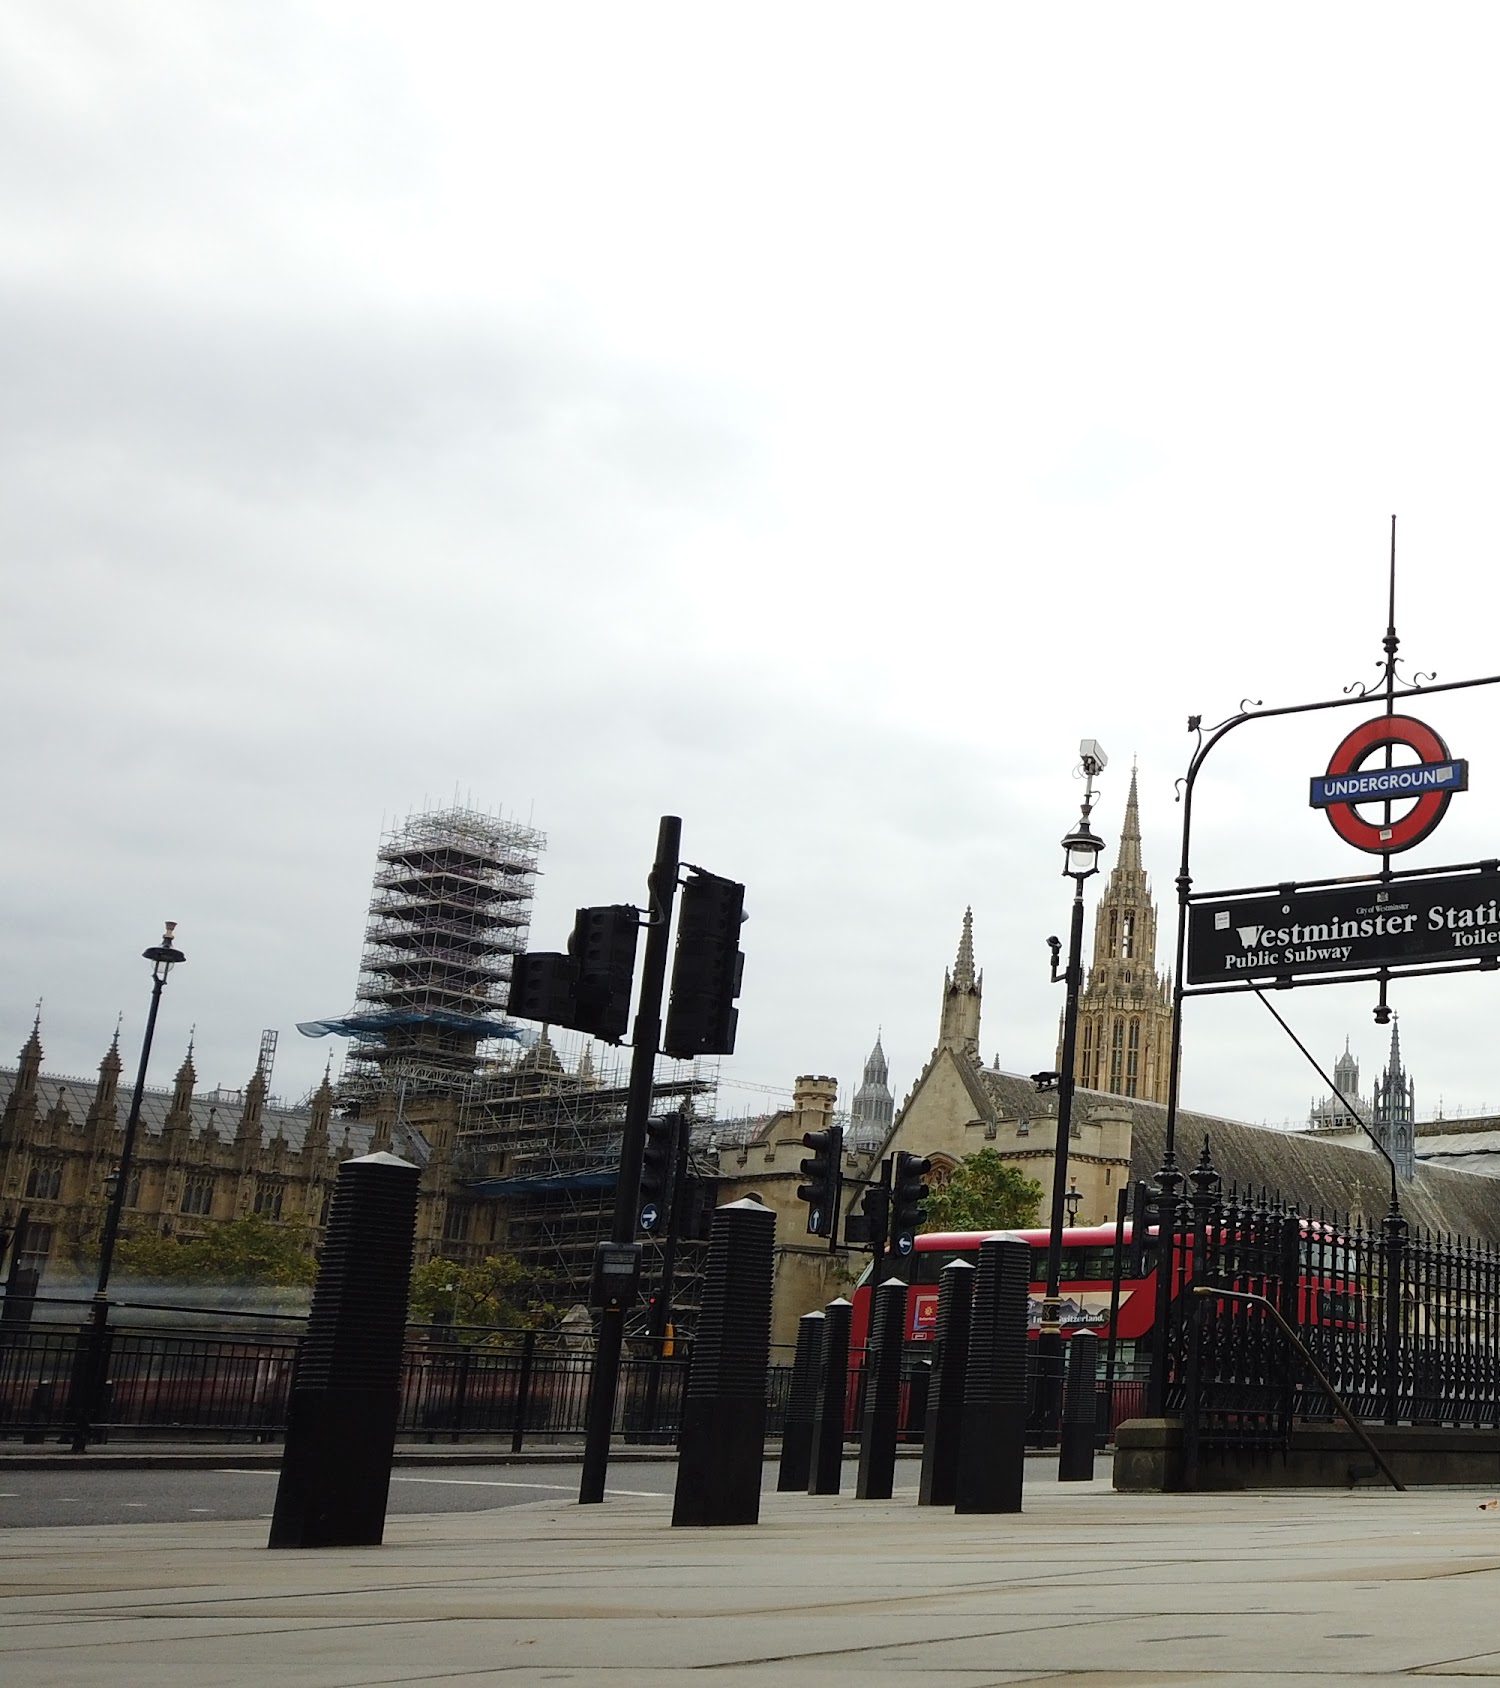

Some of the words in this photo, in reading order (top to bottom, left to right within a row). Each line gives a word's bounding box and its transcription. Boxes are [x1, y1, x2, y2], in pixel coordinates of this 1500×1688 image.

[1324, 769, 1453, 797] UNDERGROUN
[1355, 907, 1367, 916] City
[1375, 903, 1410, 912] Westminster
[1235, 912, 1418, 950] Westminster
[1224, 950, 1280, 970] Public
[1283, 944, 1353, 965] Subway
